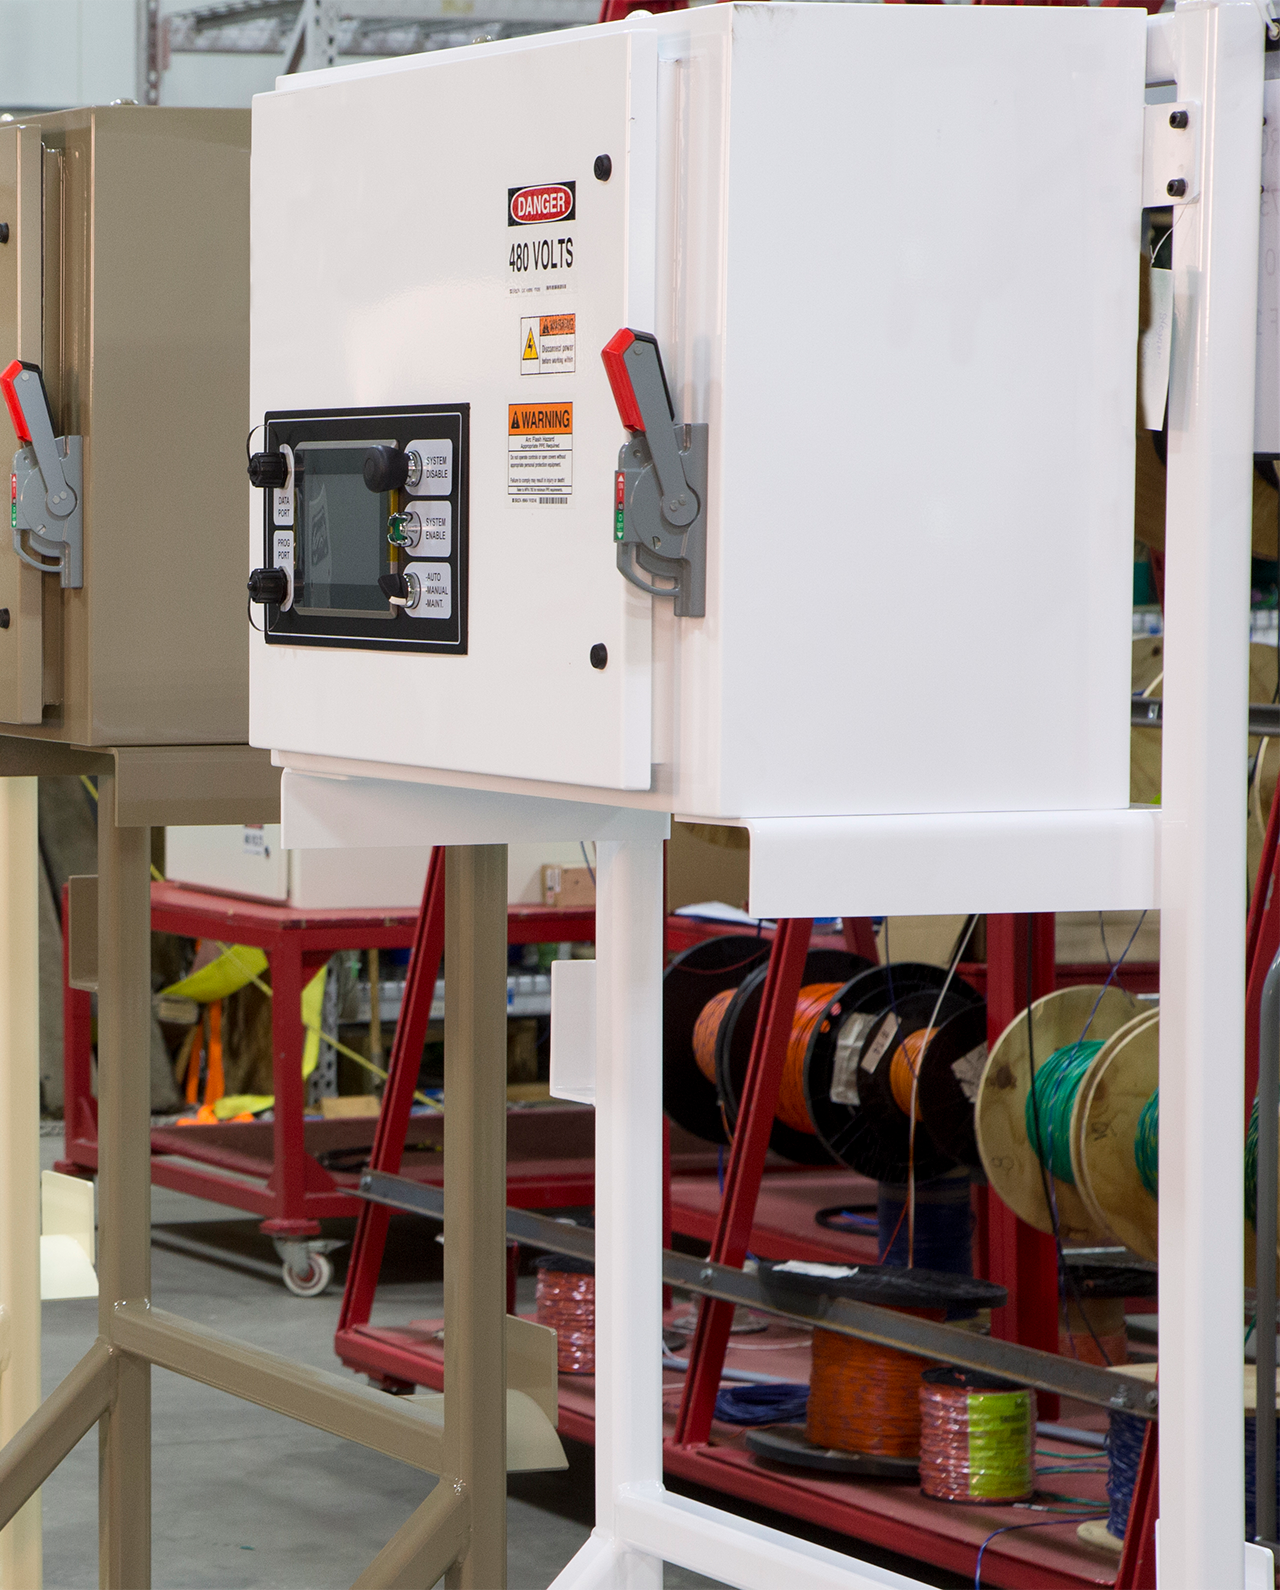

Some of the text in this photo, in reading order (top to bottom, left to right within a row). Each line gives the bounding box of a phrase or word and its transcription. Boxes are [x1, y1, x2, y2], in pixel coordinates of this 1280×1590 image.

[518, 193, 565, 216] DANGER
[509, 237, 573, 272] 480 VOLTS
[521, 410, 570, 428] WARNING
[426, 456, 446, 465] SYSTEM
[426, 469, 448, 478] DISABLE
[278, 496, 290, 505] DATA
[278, 509, 290, 517] PORT
[426, 518, 446, 526] SYSTEM
[426, 531, 446, 540] ENABLE
[278, 539, 290, 547] PROG
[278, 551, 290, 559] PORT
